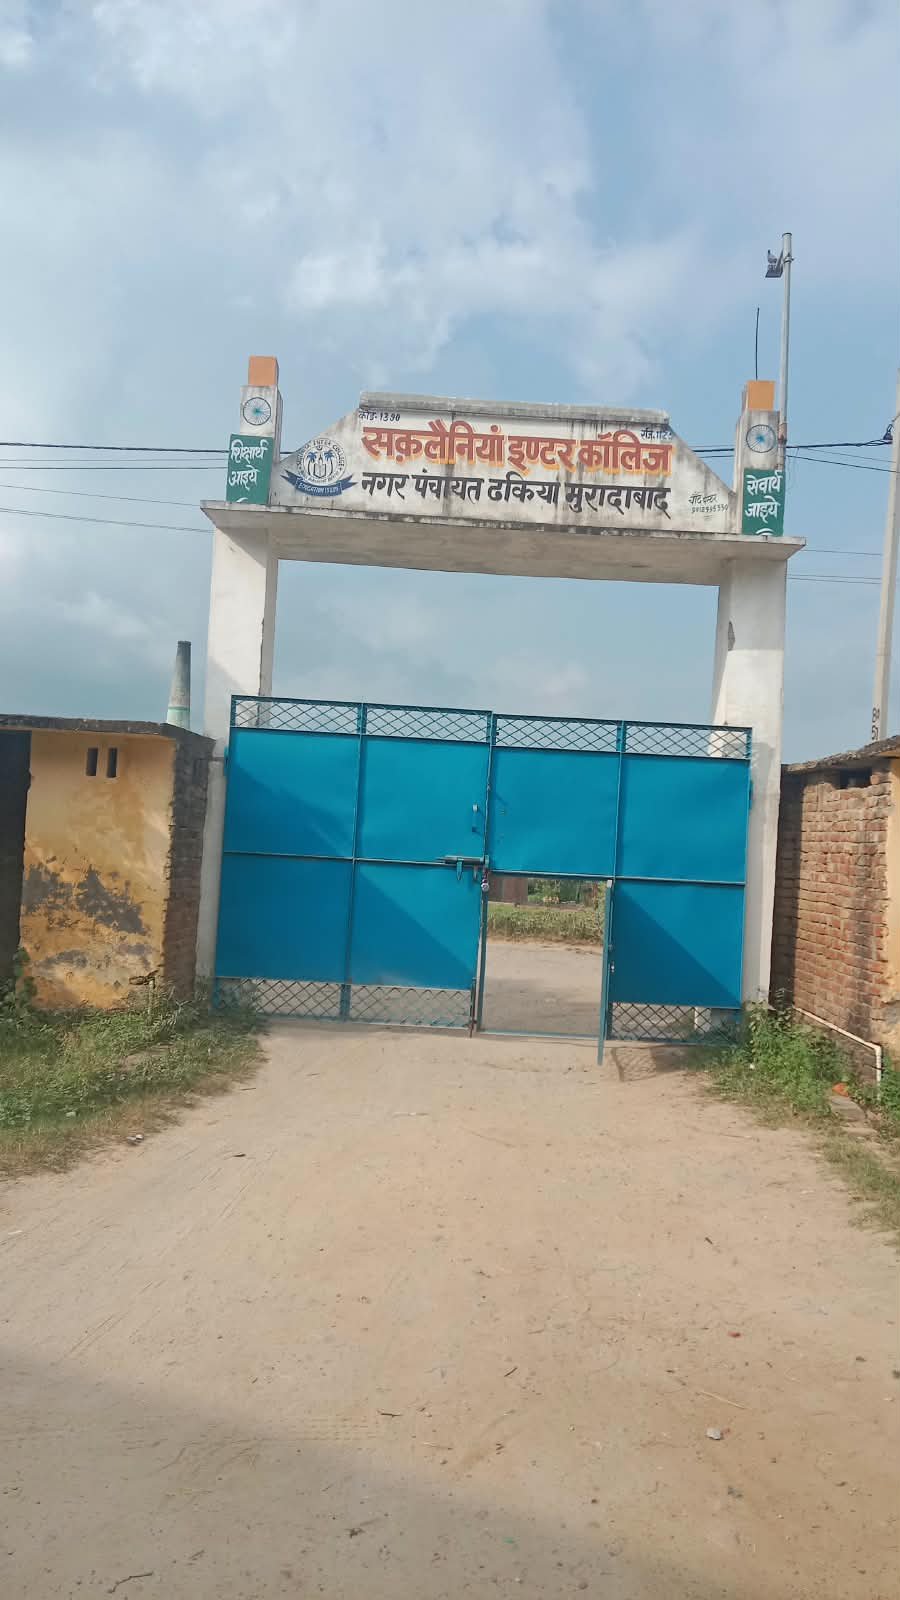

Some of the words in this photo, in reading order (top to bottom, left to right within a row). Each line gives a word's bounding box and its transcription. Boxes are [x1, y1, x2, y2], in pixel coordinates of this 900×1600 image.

[230, 439, 269, 464] शिक्षार्थ
[507, 435, 576, 475] इण्टर
[577, 429, 674, 475] कॉलिज
[228, 464, 260, 492] आइये
[746, 469, 783, 496] सेवार्थ
[361, 472, 410, 500] नगर
[411, 468, 485, 504] पंचायत
[487, 470, 560, 504] ढकिया
[565, 482, 672, 519] मुरादाबाद
[745, 495, 781, 523] जाइये
